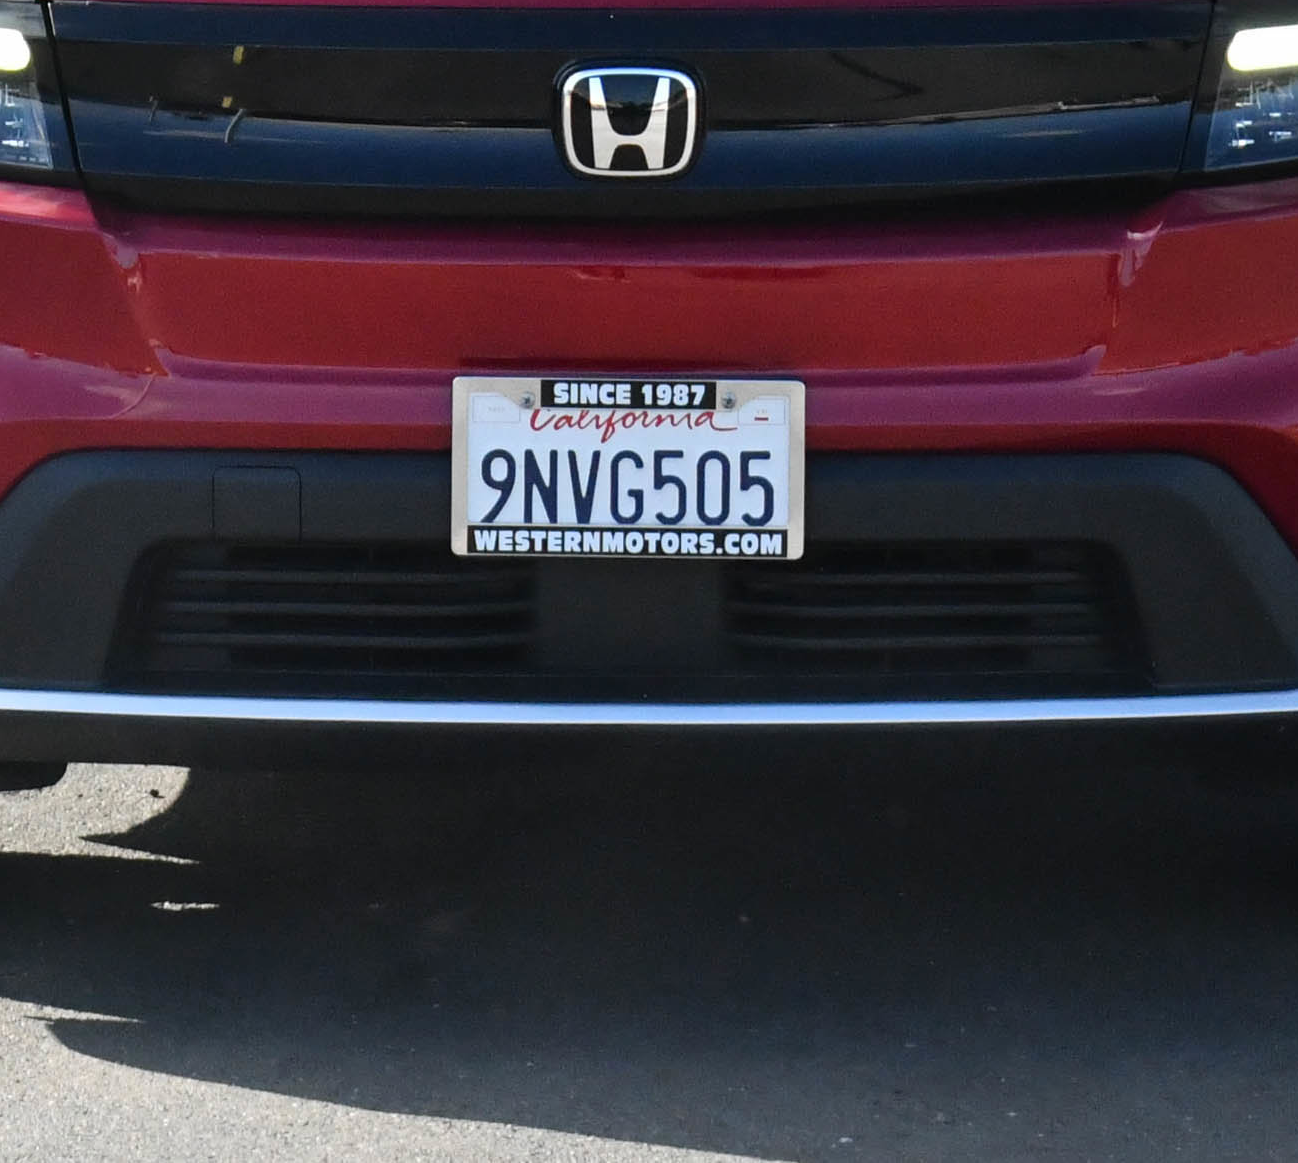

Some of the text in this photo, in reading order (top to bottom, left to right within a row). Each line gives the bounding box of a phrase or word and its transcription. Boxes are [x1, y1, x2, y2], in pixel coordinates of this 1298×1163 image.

[553, 382, 706, 407] SINCE 1987
[529, 408, 738, 443] California
[480, 448, 775, 527] 9NVG505
[474, 529, 783, 556] WESTERNMOTORS.COM
